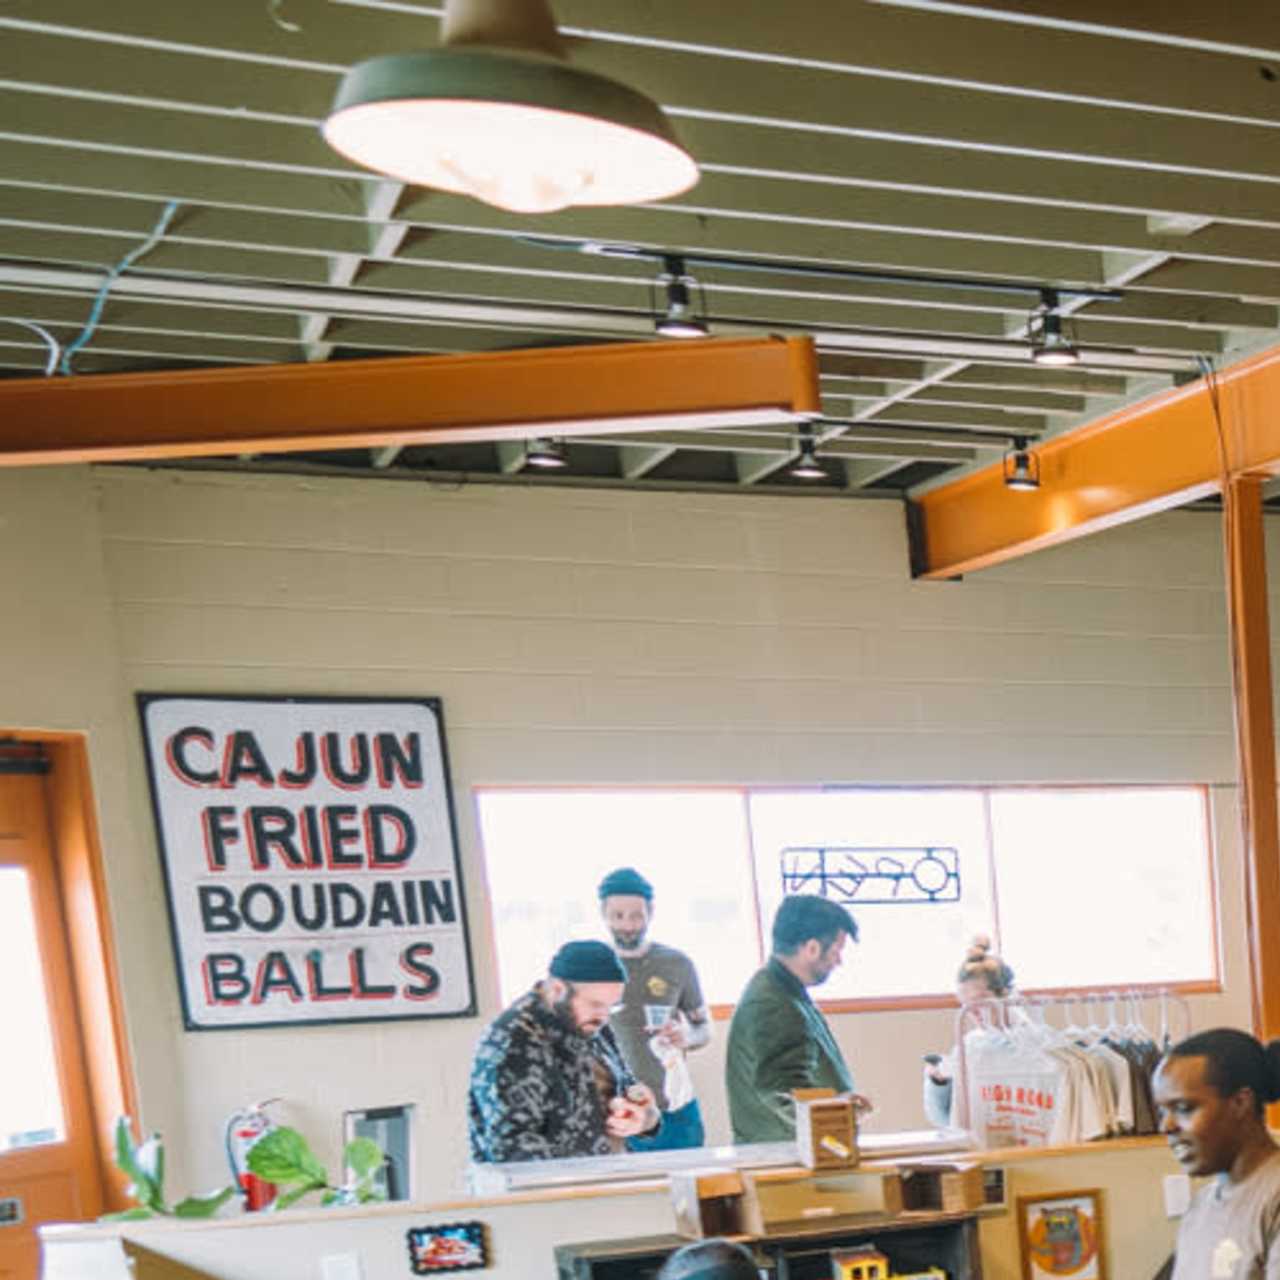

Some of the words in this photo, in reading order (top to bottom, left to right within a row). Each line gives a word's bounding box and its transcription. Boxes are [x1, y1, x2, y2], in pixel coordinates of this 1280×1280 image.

[166, 726, 424, 791] CAJUN
[201, 803, 417, 871] FRIED
[197, 880, 456, 932] BOUDAIN
[201, 942, 440, 1006] BALLS
